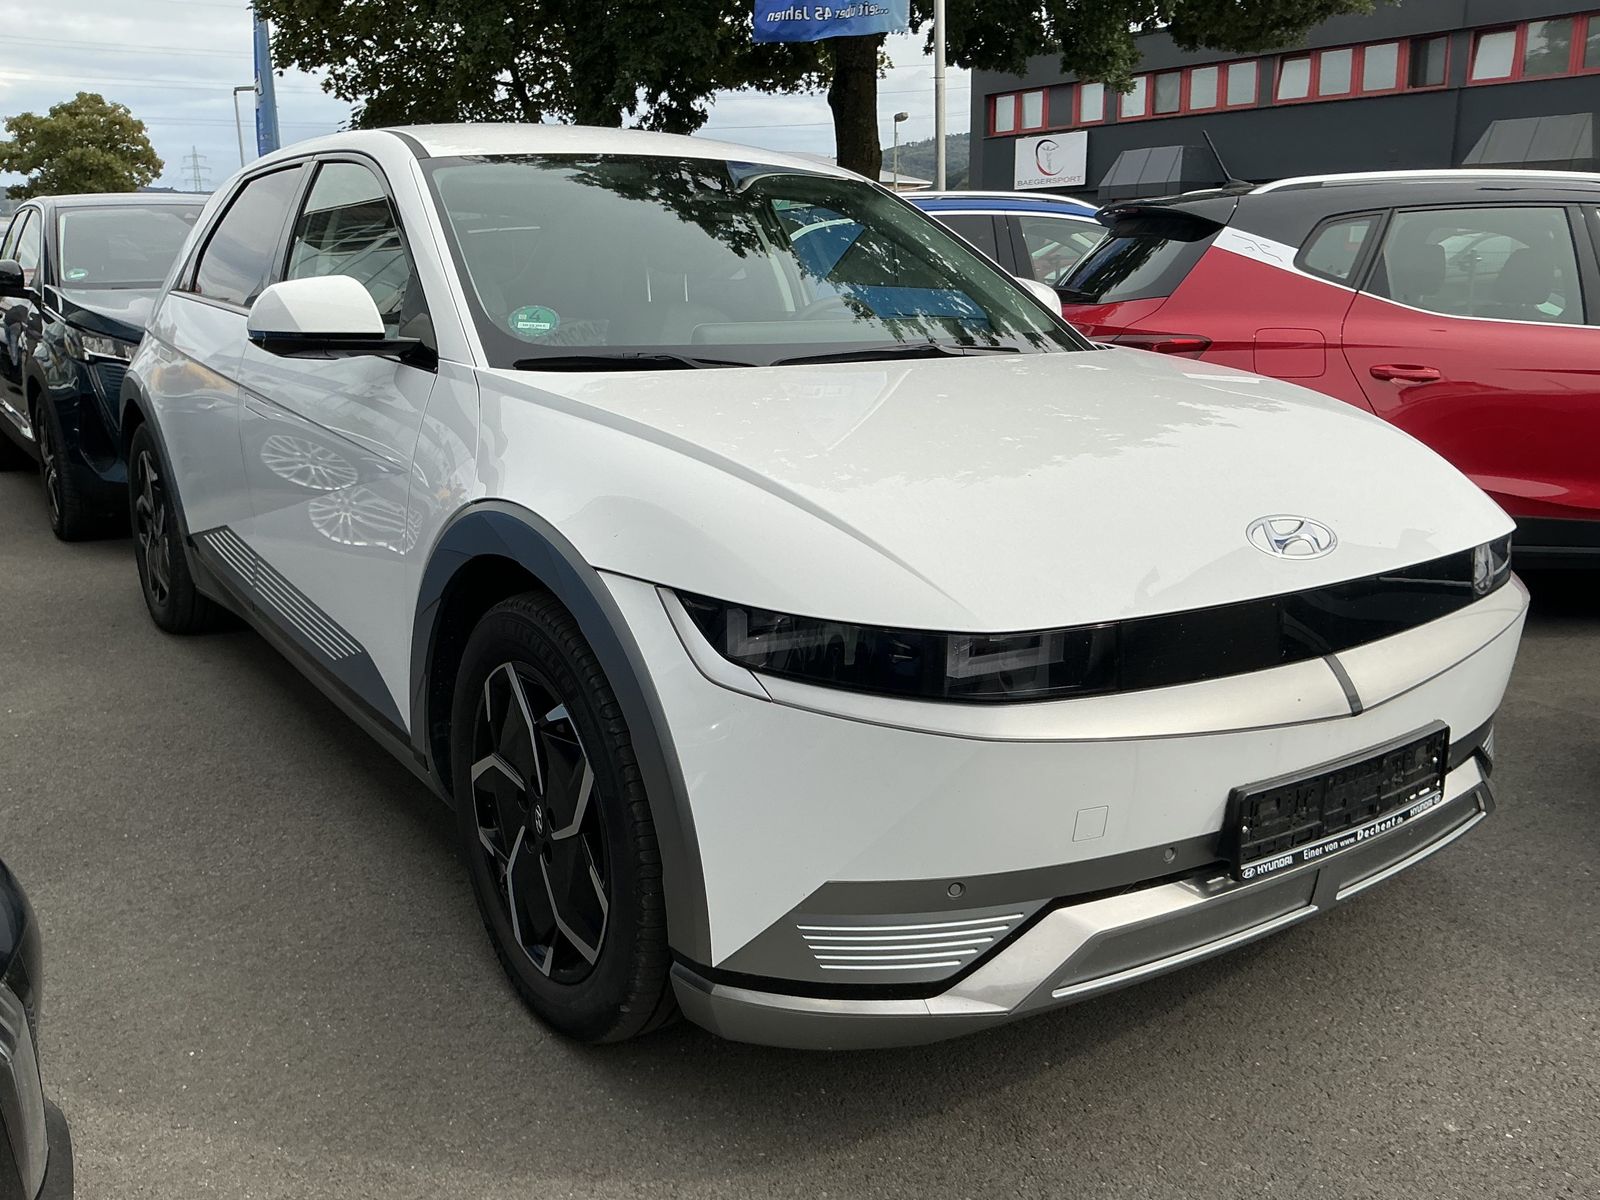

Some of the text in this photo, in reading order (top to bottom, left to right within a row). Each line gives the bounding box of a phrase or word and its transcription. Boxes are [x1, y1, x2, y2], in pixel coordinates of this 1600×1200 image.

[1017, 175, 1081, 187] BAEGERSPORT
[529, 309, 541, 321] 4
[1257, 855, 1293, 874] HYUNDAI
[1303, 847, 1323, 860] Einer
[1324, 841, 1338, 853] von
[1410, 799, 1433, 816] HYUNDAI
